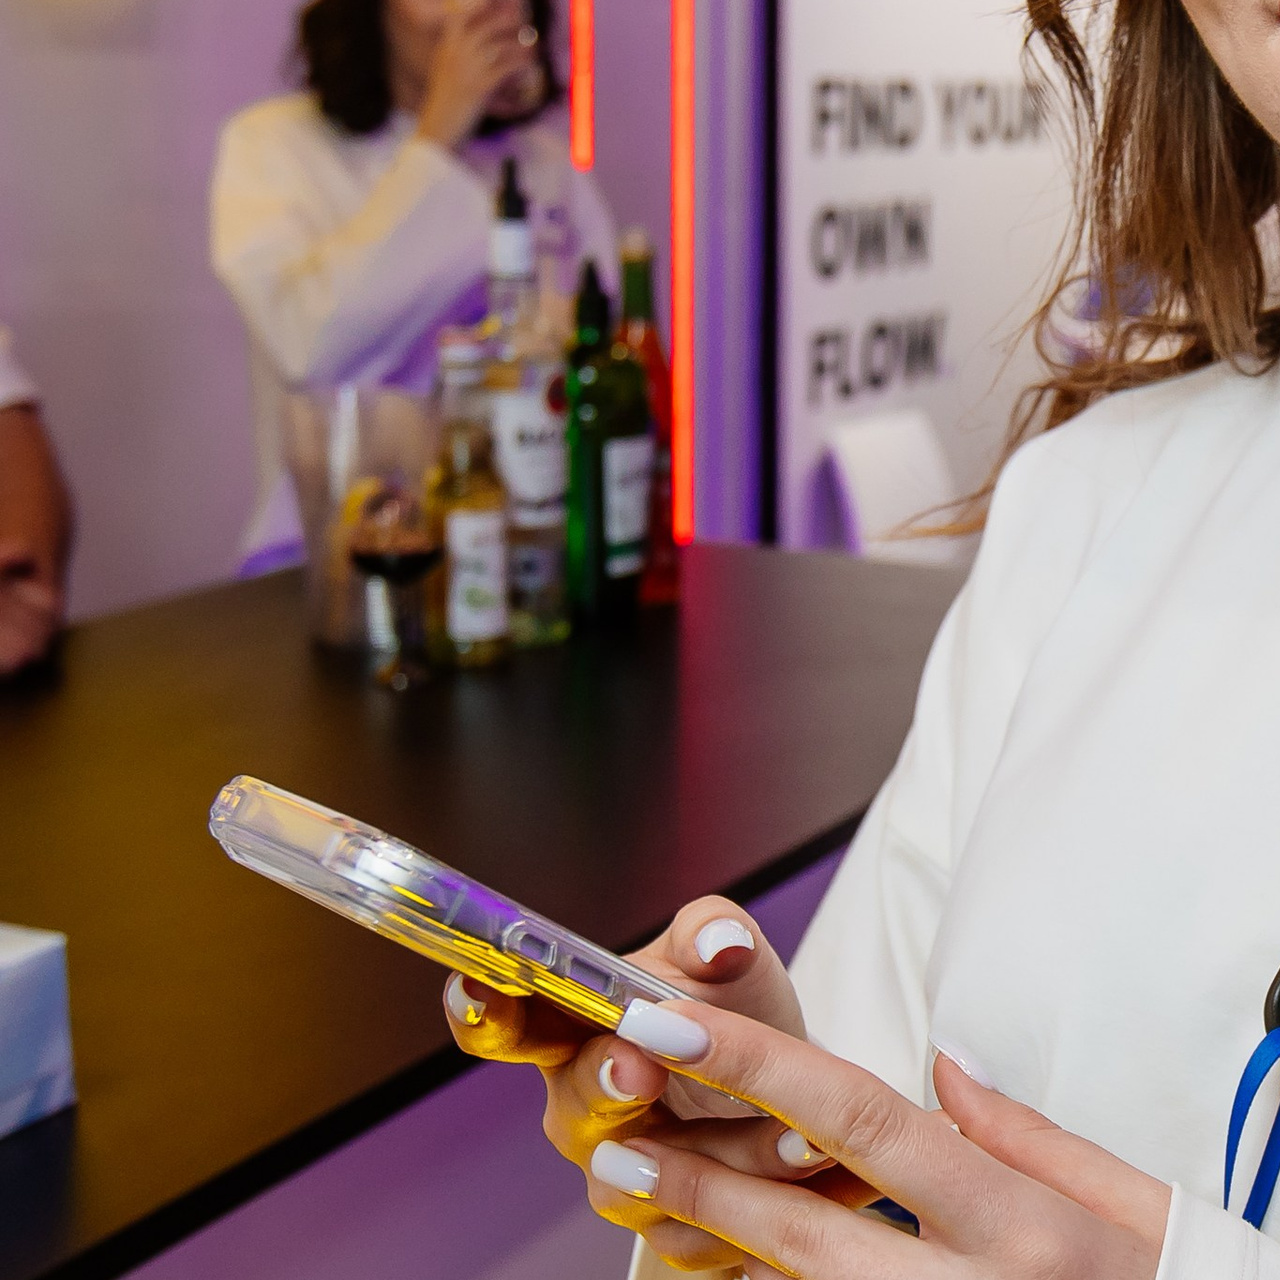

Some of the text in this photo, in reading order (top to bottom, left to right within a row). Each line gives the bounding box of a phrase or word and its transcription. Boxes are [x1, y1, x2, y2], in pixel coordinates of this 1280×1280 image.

[812, 78, 917, 152] FIND
[811, 198, 932, 276] OWN
[808, 312, 948, 402] FLOW
